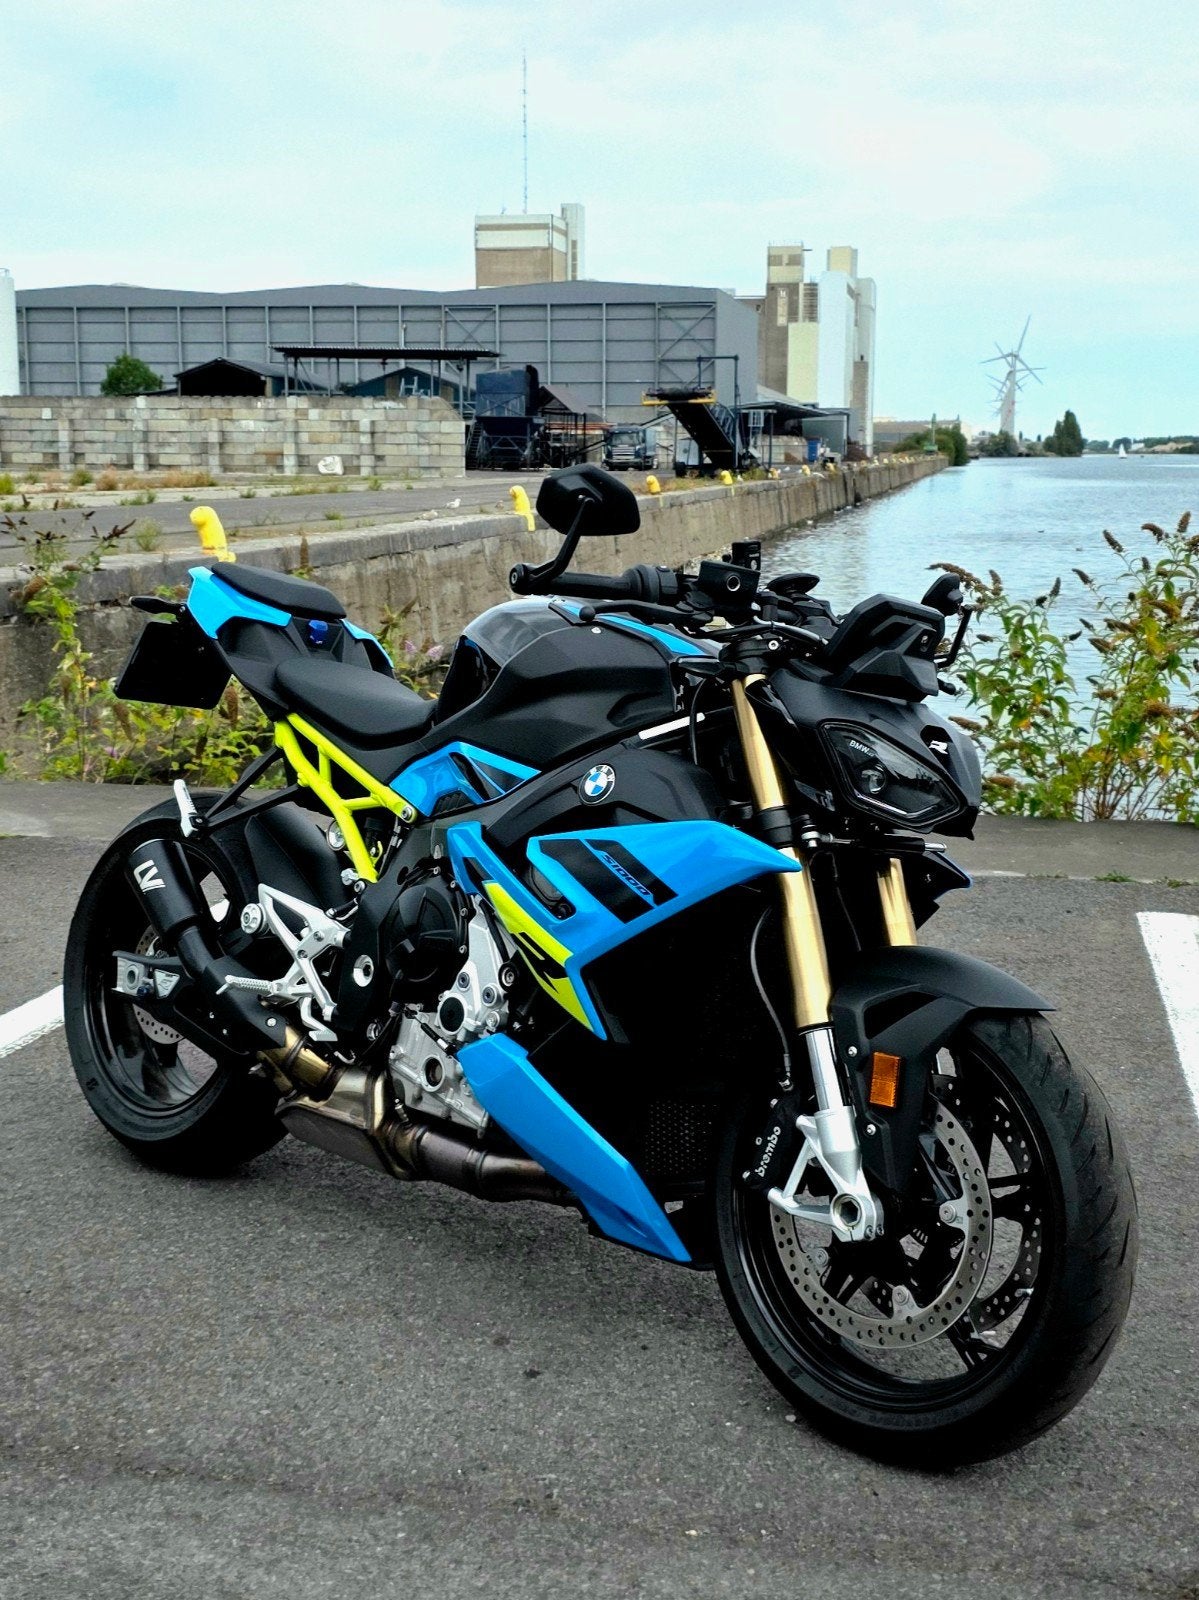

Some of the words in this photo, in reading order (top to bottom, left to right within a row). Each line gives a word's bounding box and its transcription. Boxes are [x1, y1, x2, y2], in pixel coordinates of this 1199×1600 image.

[850, 740, 870, 753] BMW
[133, 860, 165, 891] LV
[755, 1126, 781, 1177] brembo
